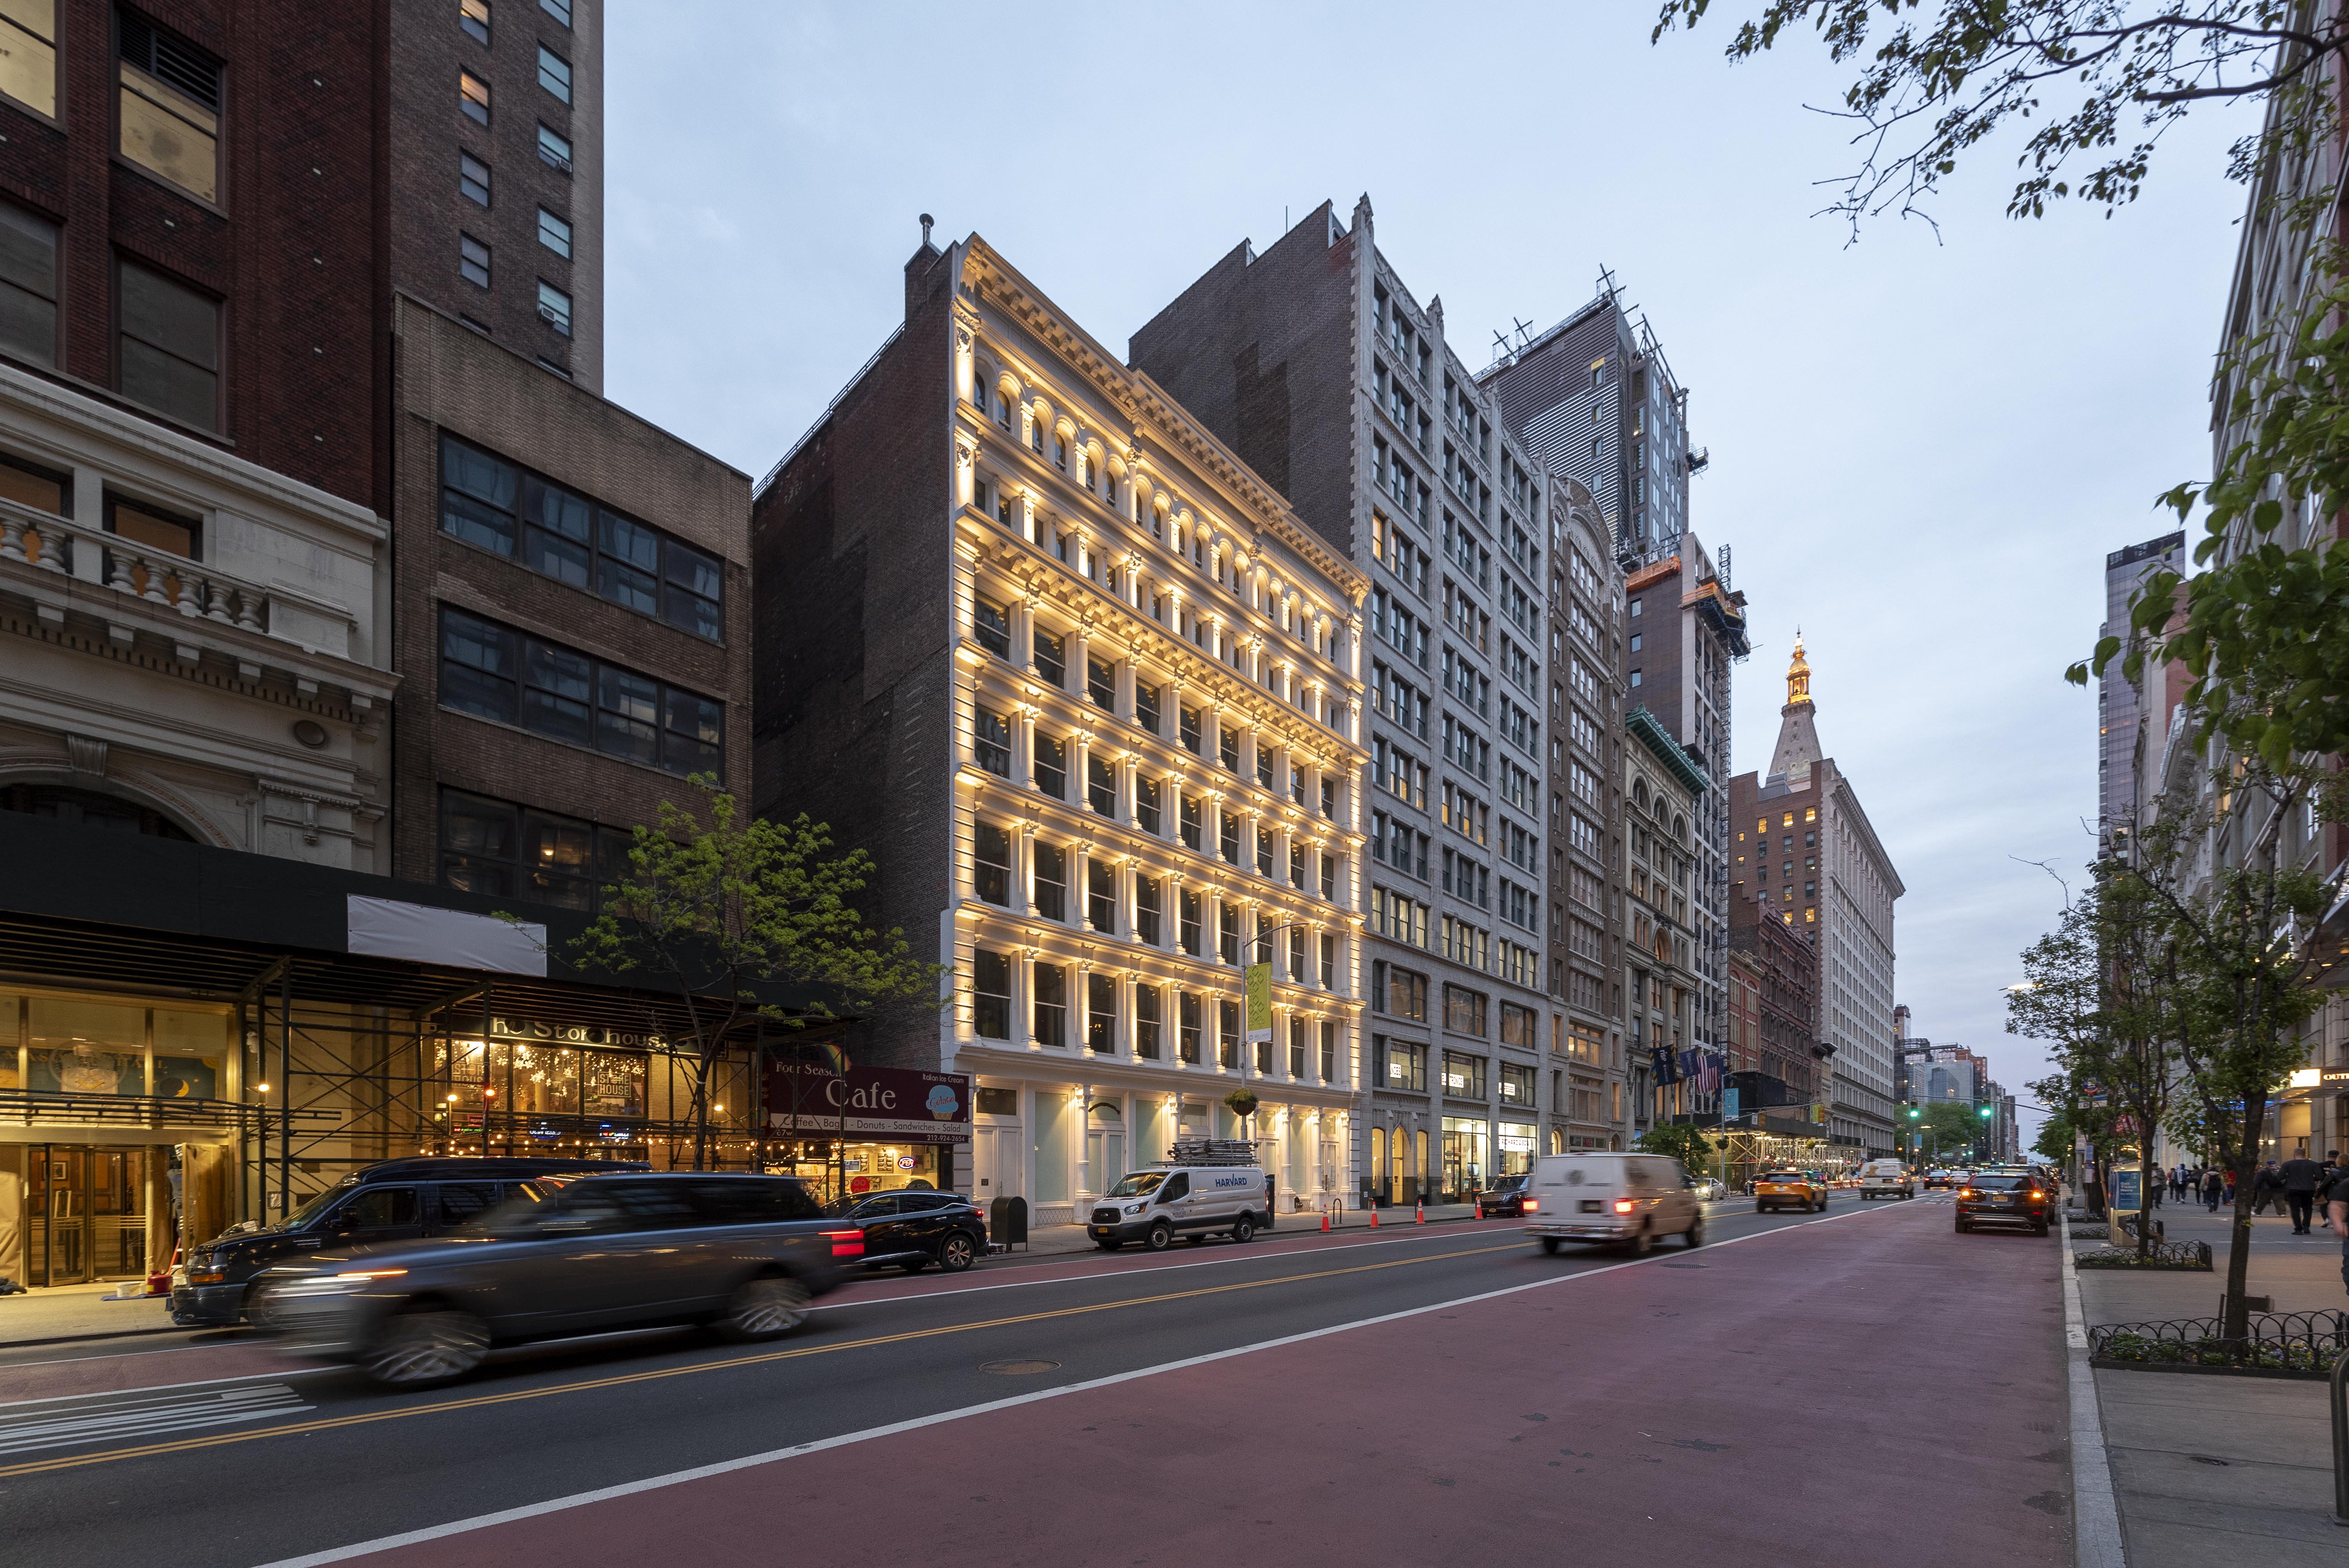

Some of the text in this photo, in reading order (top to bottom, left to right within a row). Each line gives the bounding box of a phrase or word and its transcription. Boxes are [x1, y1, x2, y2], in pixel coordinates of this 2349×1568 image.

[454, 1063, 484, 1076] STOR
[454, 1075, 484, 1087] HOUS
[600, 1074, 629, 1085] STORE
[923, 1073, 938, 1081] Italian
[600, 1084, 629, 1095] HOUSE
[826, 1079, 896, 1109] Cafe
[930, 1096, 955, 1108] Gelato
[824, 1118, 847, 1130] Bagl
[857, 1120, 885, 1130] Donuts
[893, 1122, 935, 1131] Sandwiches
[942, 1123, 961, 1132] Salad
[1215, 1174, 1247, 1187] HARVARD
